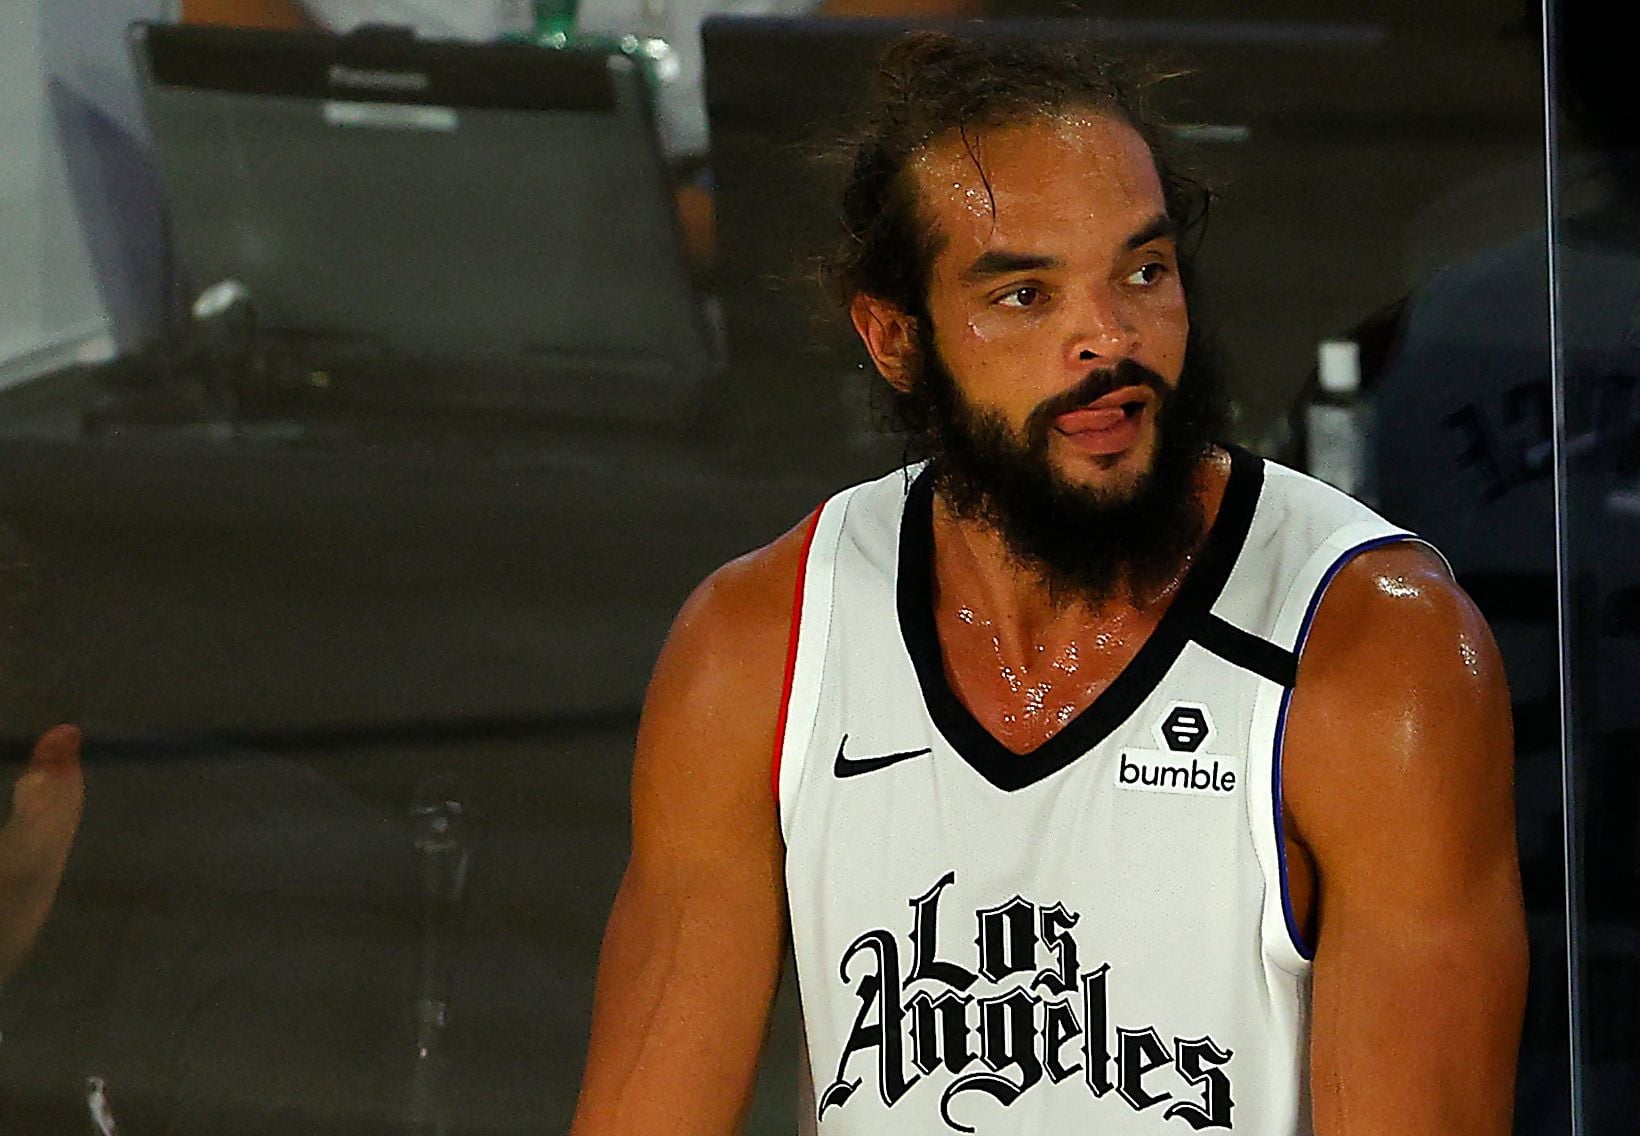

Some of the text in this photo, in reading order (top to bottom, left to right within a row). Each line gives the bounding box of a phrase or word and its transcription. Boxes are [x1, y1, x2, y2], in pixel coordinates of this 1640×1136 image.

[1120, 753, 1236, 791] bumble
[903, 871, 1079, 992] Los
[818, 928, 1235, 1133] Angeles
